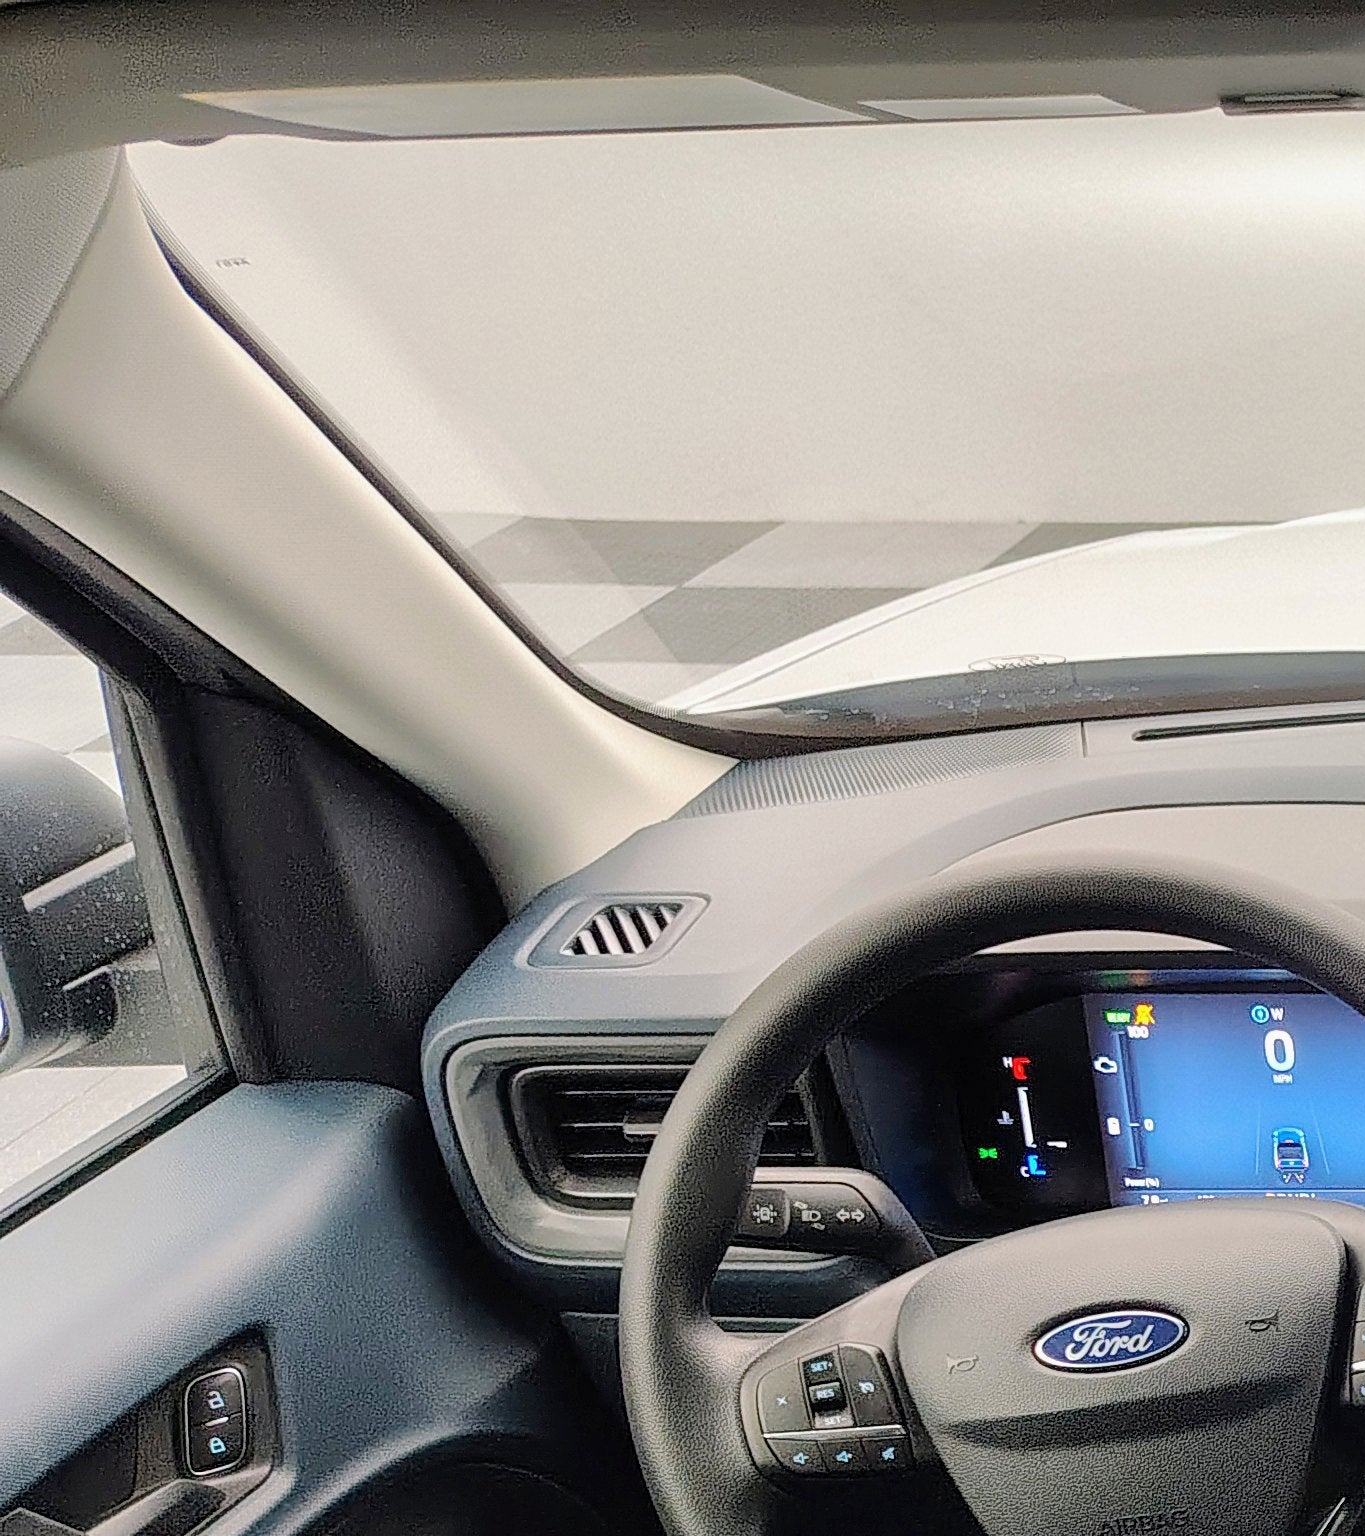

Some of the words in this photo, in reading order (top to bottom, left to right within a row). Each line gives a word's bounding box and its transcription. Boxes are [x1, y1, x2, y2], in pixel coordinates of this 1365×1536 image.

[1269, 1007, 1284, 1021] W
[1126, 1025, 1150, 1039] 100
[1264, 1029, 1295, 1072] 0
[1002, 1056, 1013, 1068] H
[1064, 1319, 1154, 1361] Ford
